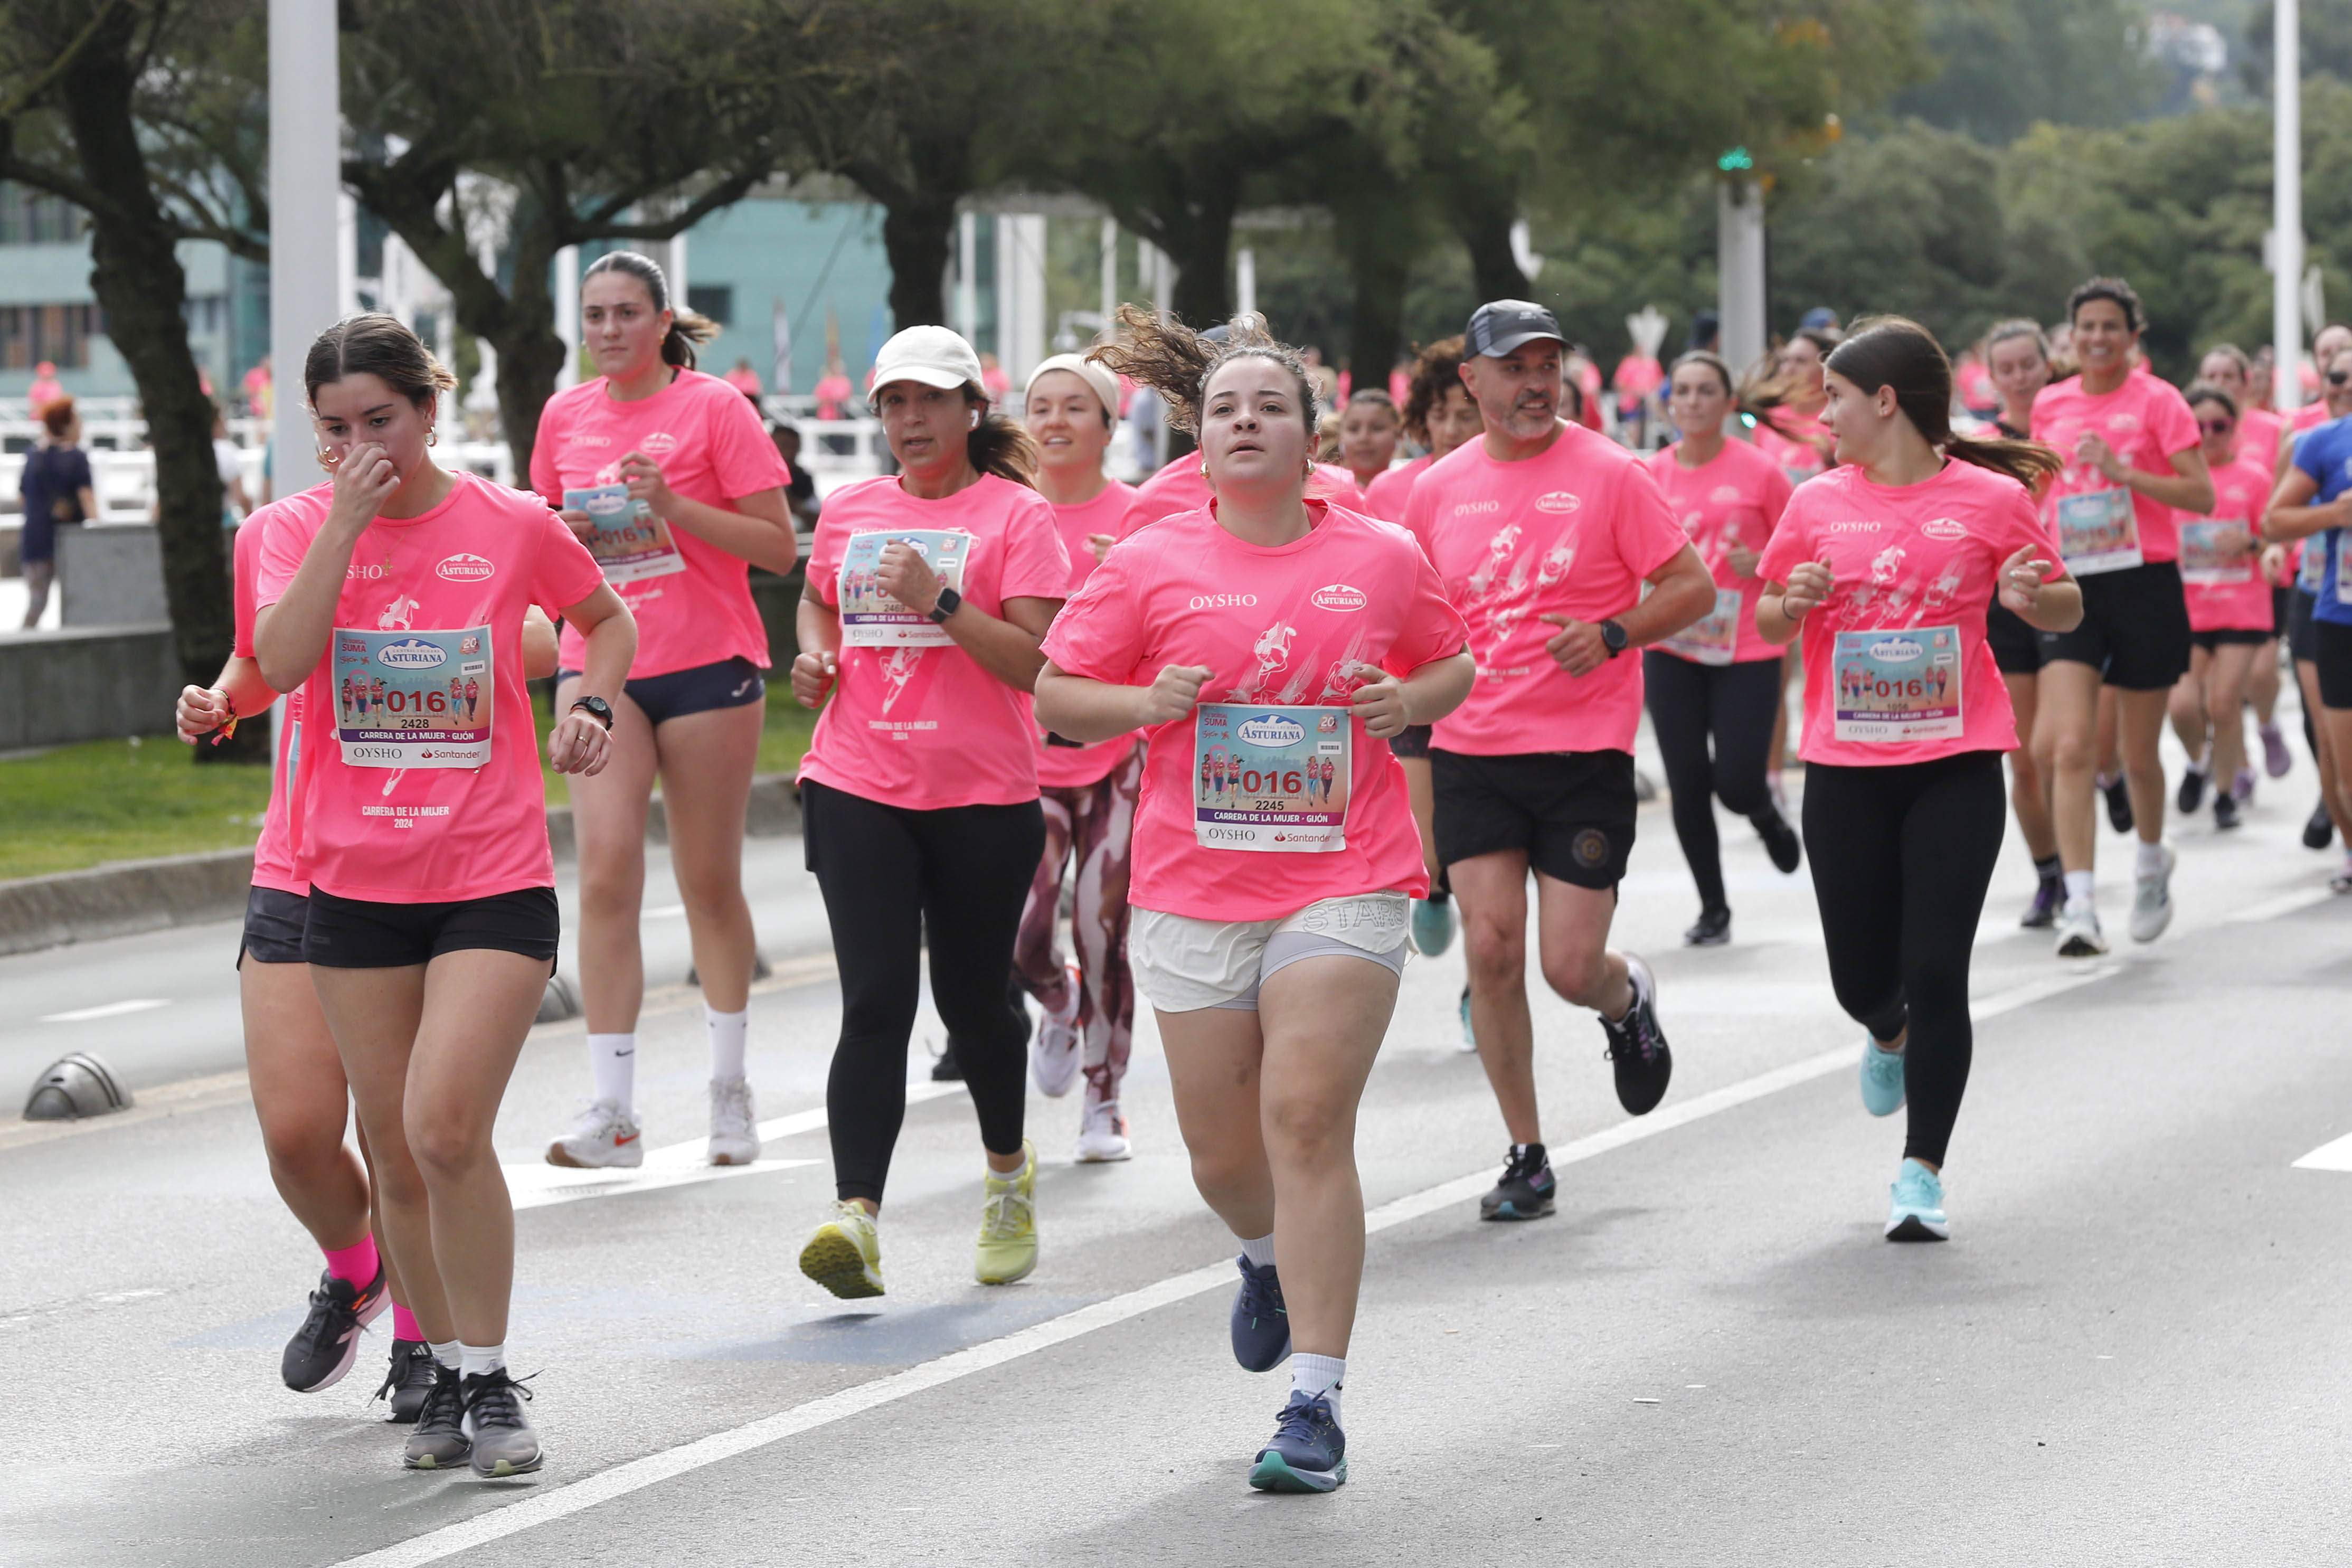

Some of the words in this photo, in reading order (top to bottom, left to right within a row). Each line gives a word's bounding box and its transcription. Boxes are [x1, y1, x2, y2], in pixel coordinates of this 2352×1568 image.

[1830, 522, 1882, 533] OYSHO
[601, 528, 637, 544] 016
[346, 565, 383, 579] SHO
[441, 564, 490, 575] ASTURIANA
[1189, 594, 1257, 610] OYSHO
[1317, 594, 1363, 605] ASTURIANA
[342, 644, 366, 652] SUMA
[463, 637, 478, 649] 20
[382, 650, 443, 662] ASTURIANA
[1875, 679, 1922, 697] 016
[387, 691, 446, 712] 016
[401, 719, 429, 729] 2428
[1204, 717, 1227, 726] SUMA
[1321, 716, 1335, 727] 20
[359, 731, 393, 740] CARRERA
[452, 731, 474, 740] GIJÓN
[1241, 726, 1301, 739] ASTURIANA
[354, 748, 402, 759] OYSHO
[434, 750, 481, 759] Santander
[1242, 770, 1302, 793] 016
[1255, 800, 1284, 810] 2245
[362, 806, 395, 816] CARRERA
[396, 806, 407, 816] DE
[409, 807, 419, 816] LA
[421, 806, 449, 816] MUJER
[1214, 811, 1247, 821] CARRERA
[1273, 814, 1300, 823] MUJER
[1306, 813, 1328, 823] GIJÓN
[394, 818, 413, 828] 2024
[1208, 828, 1255, 841] OYSHO
[1288, 833, 1331, 843] Santander
[1302, 899, 1405, 932] STARS
